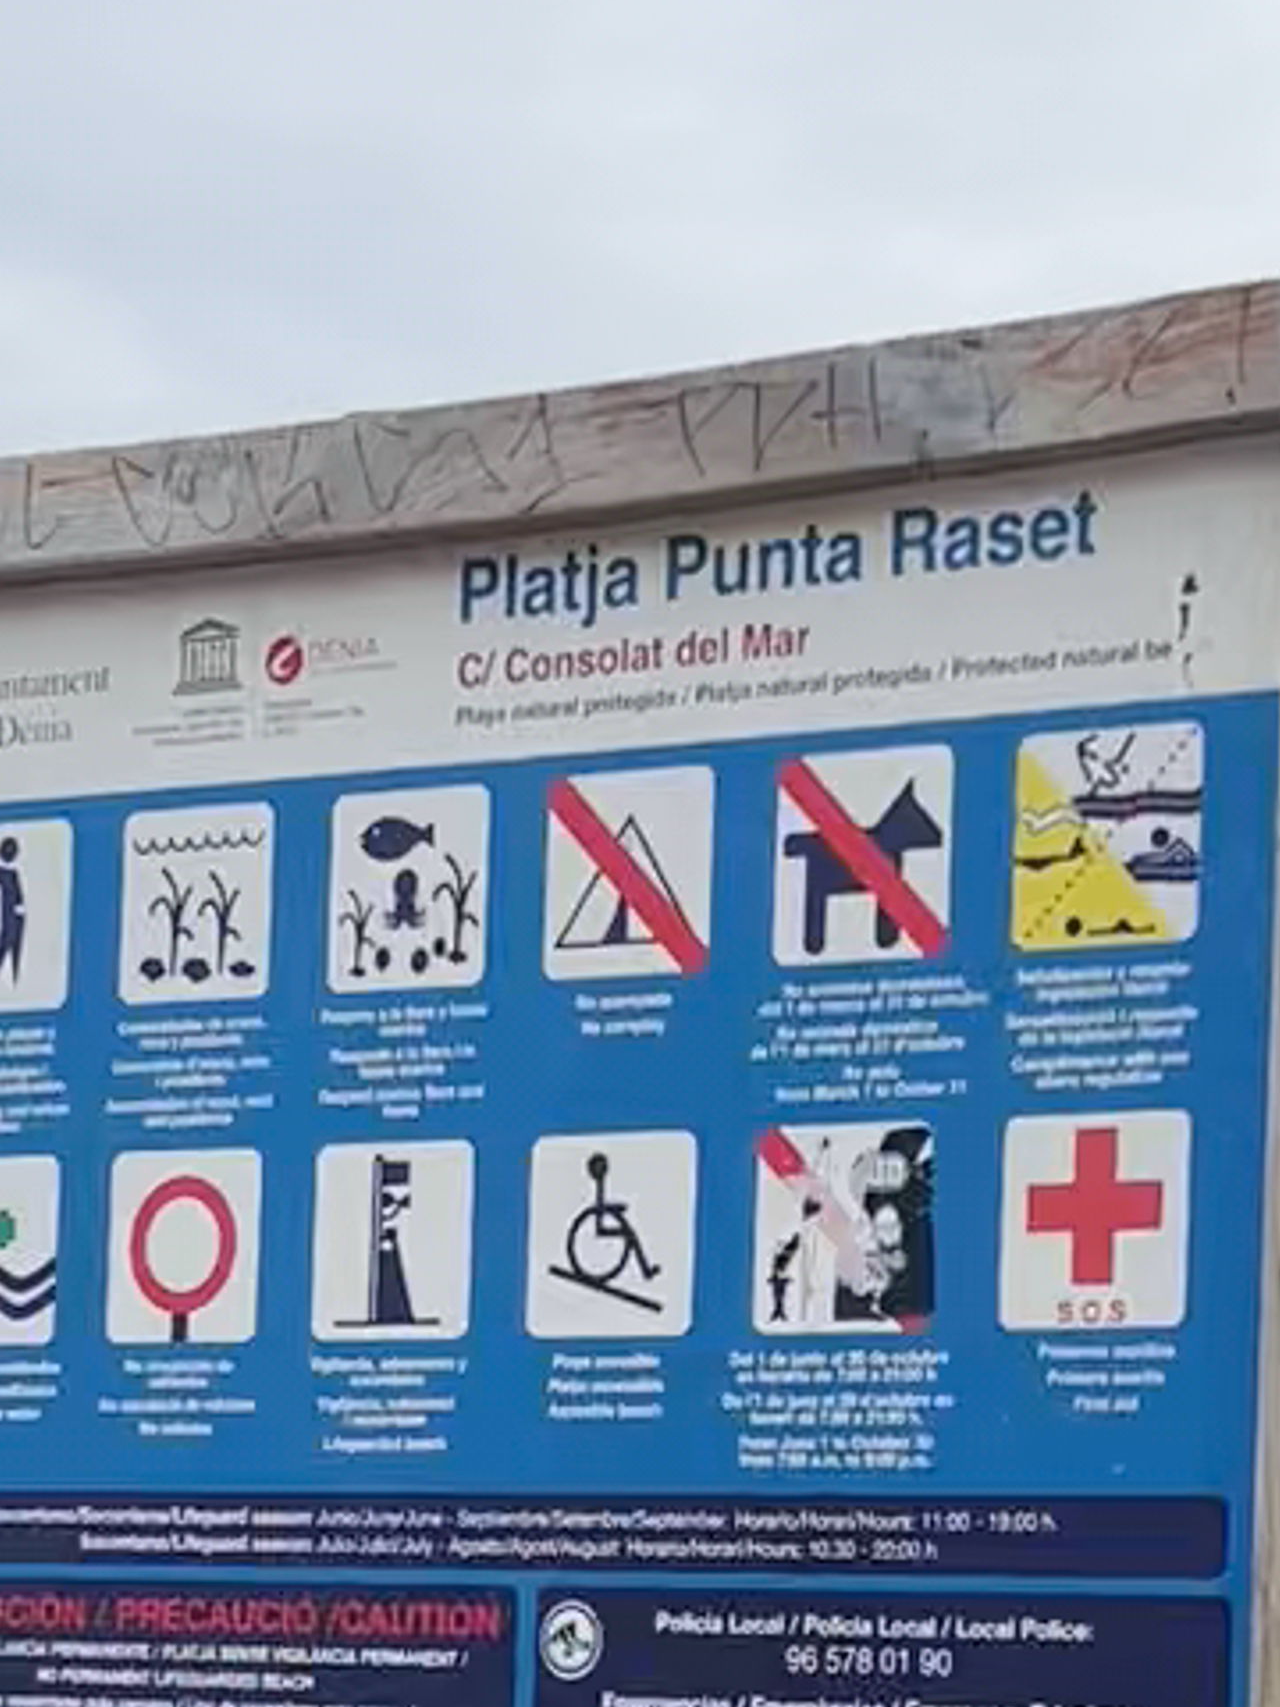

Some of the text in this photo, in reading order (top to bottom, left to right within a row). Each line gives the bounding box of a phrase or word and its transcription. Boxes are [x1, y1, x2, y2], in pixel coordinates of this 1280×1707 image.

[458, 489, 1098, 627] Platja Punta Raset
[455, 703, 506, 728] Playa
[510, 695, 580, 720] natural
[584, 687, 677, 718] protegida
[695, 679, 752, 705] Platja
[756, 673, 827, 698] natural
[832, 662, 931, 695] protegida
[951, 652, 1057, 681] Protected
[1061, 640, 1140, 670] natural
[458, 623, 810, 689] C/ Consolat del Mar
[728, 1610, 785, 1635] Local
[877, 1615, 937, 1639] Local
[955, 1615, 1016, 1640] Local
[785, 1644, 953, 1678] 96 578 01 90
